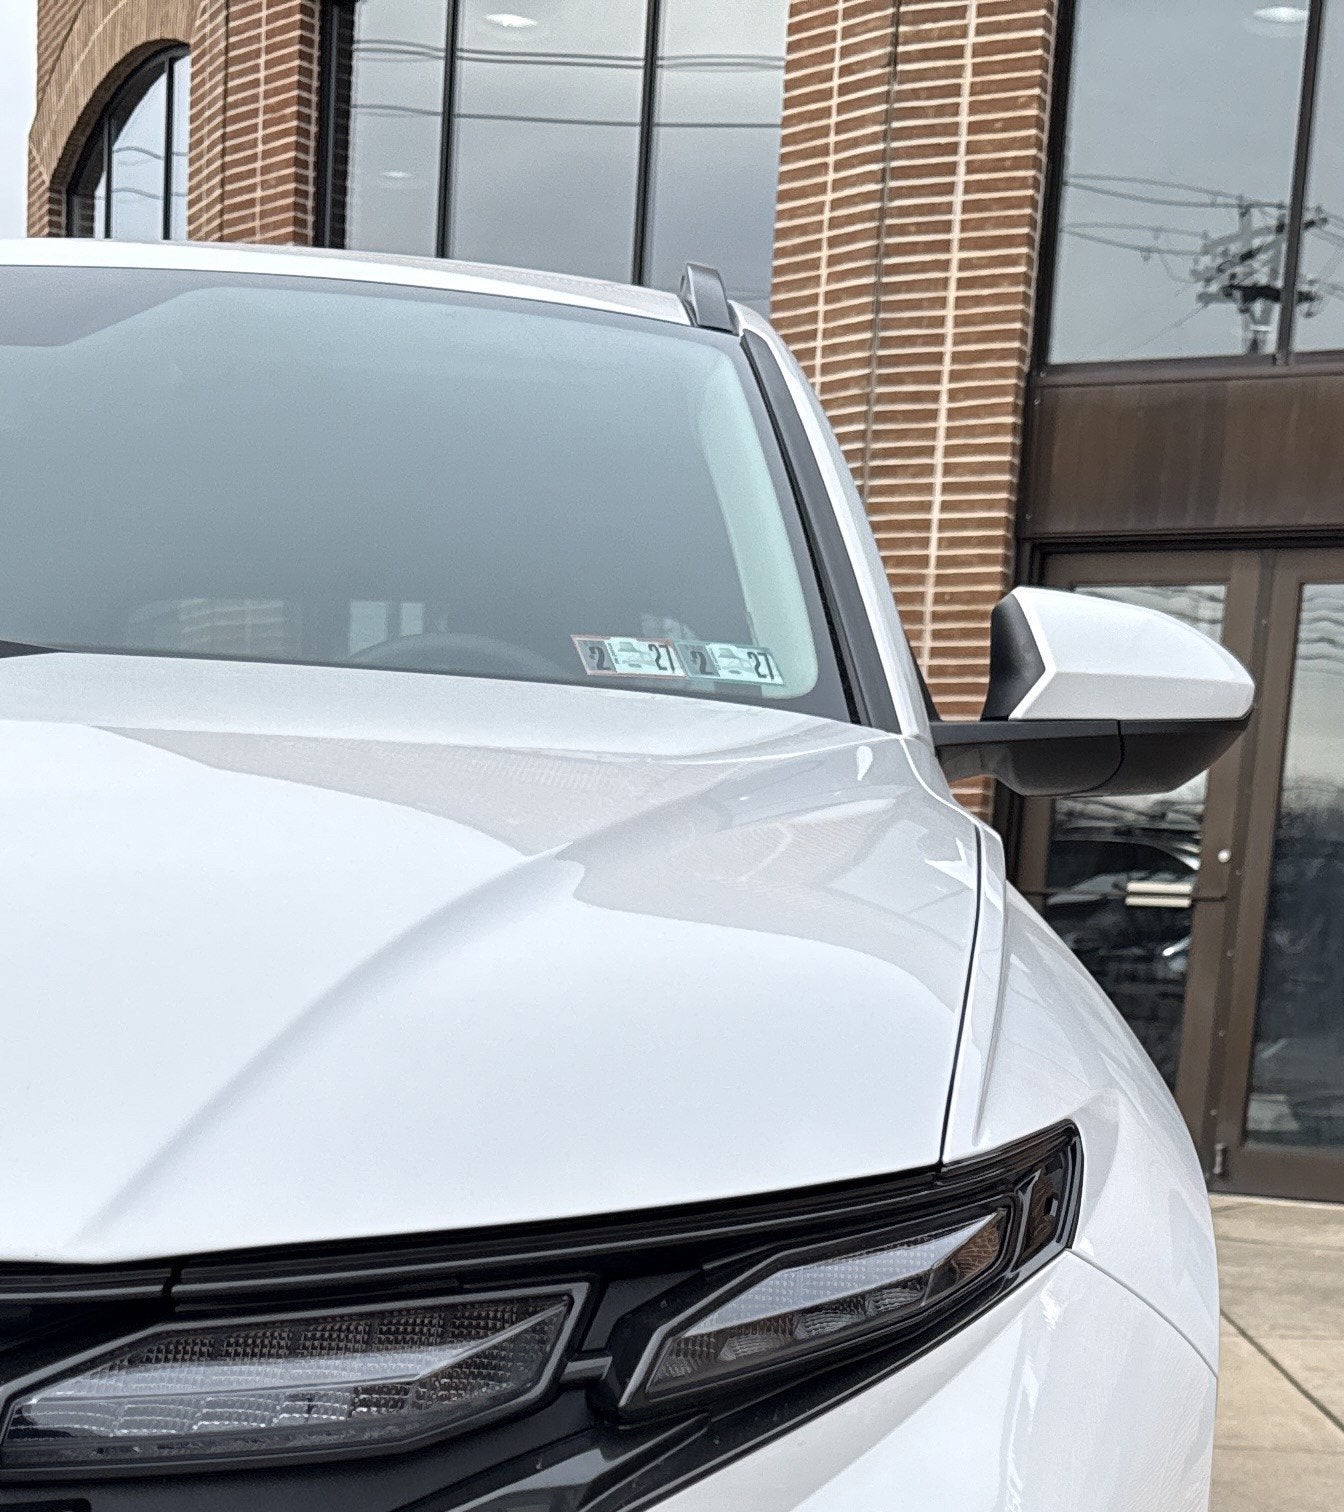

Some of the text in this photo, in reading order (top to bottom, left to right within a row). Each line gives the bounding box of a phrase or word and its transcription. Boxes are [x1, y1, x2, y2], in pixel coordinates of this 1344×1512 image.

[588, 645, 611, 671] 2
[647, 643, 676, 673] 27
[689, 650, 714, 676] 2
[746, 651, 775, 680] 27
